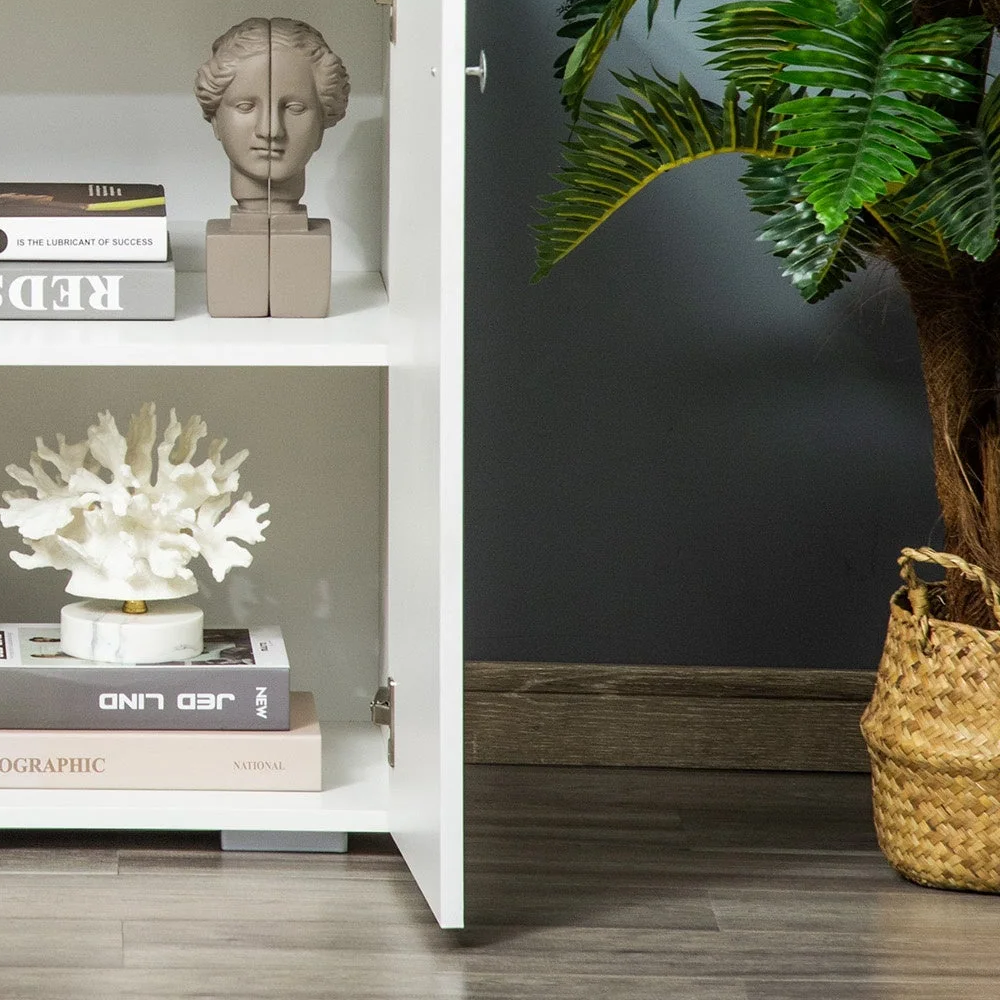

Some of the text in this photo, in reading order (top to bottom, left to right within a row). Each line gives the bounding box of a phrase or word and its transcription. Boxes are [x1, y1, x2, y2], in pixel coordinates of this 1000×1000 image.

[99, 693, 235, 710] JED LIND
[255, 687, 267, 719] NEW
[234, 760, 285, 770] NATIONAL
